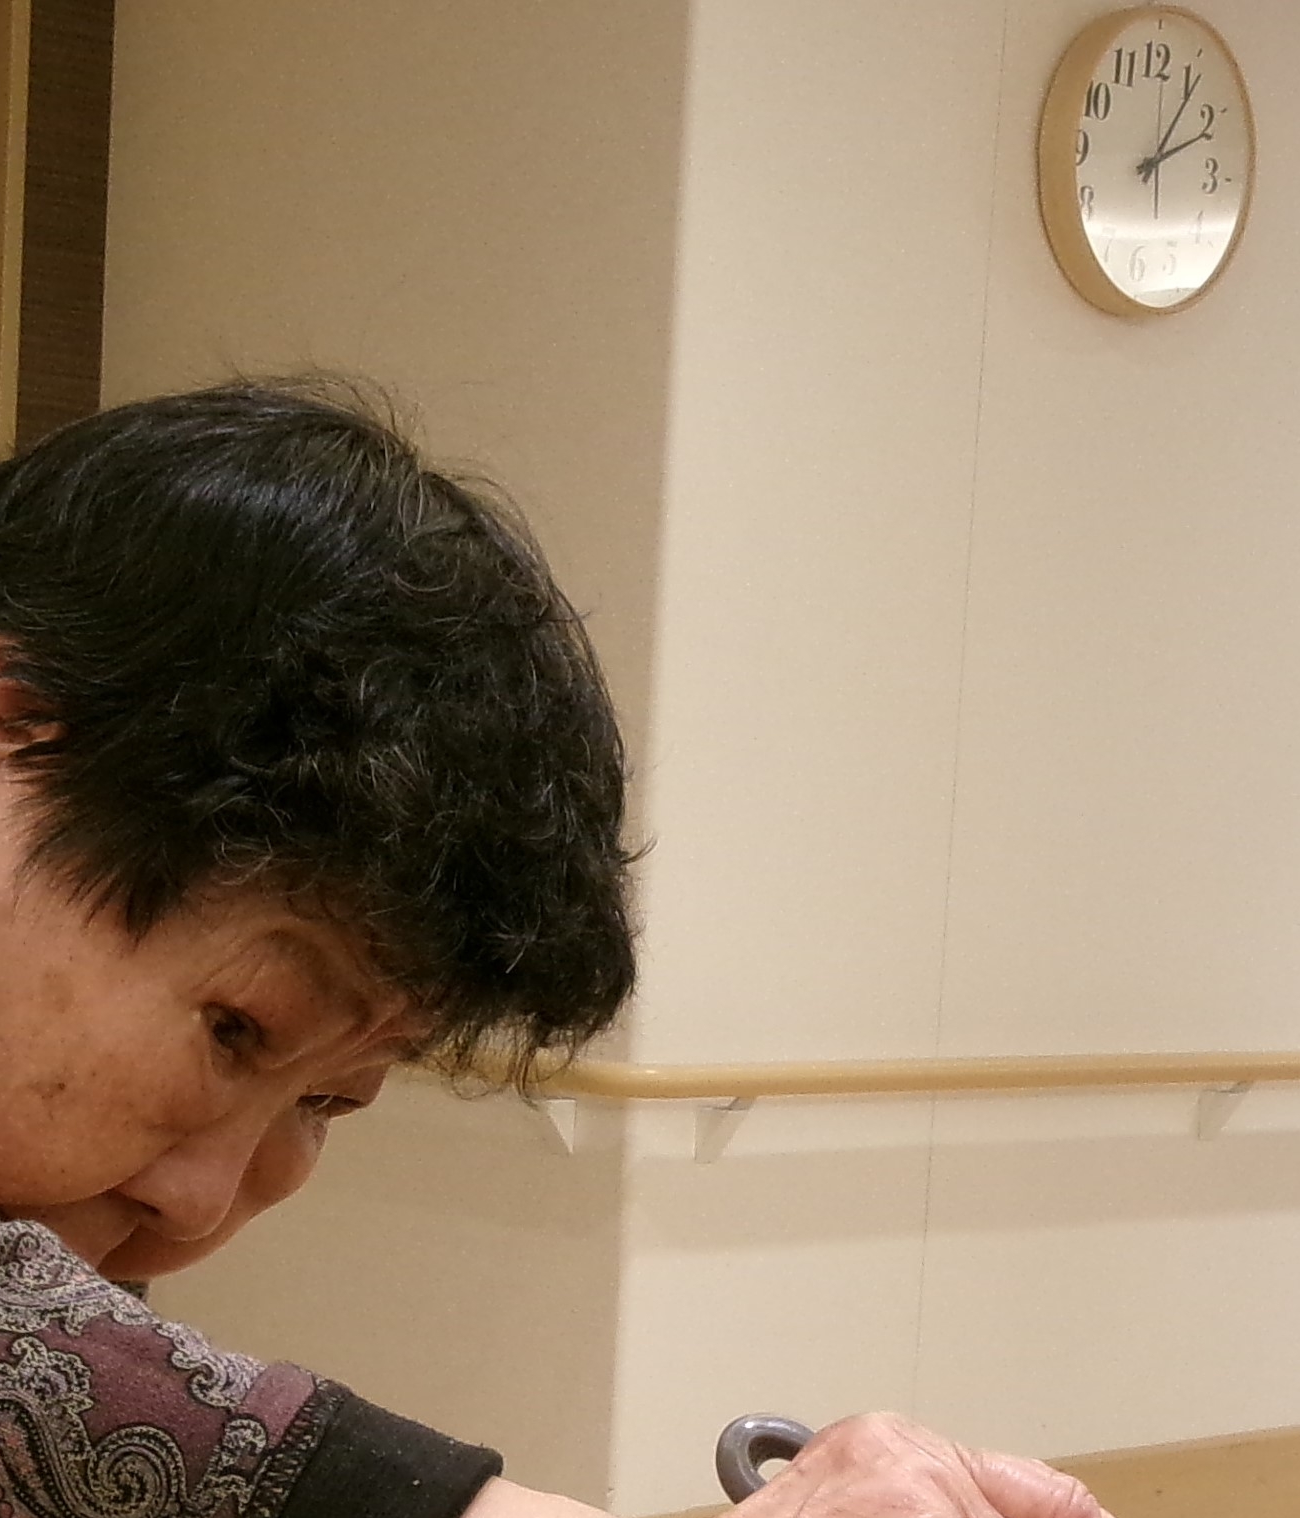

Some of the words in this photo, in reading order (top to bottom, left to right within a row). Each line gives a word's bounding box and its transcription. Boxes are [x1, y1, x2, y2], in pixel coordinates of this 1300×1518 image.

[1114, 48, 1136, 88] 11
[1142, 41, 1170, 82] 12
[1084, 80, 1111, 121] 10
[1200, 104, 1215, 141] 2
[1201, 157, 1219, 194] 3
[1129, 245, 1146, 282] 6
